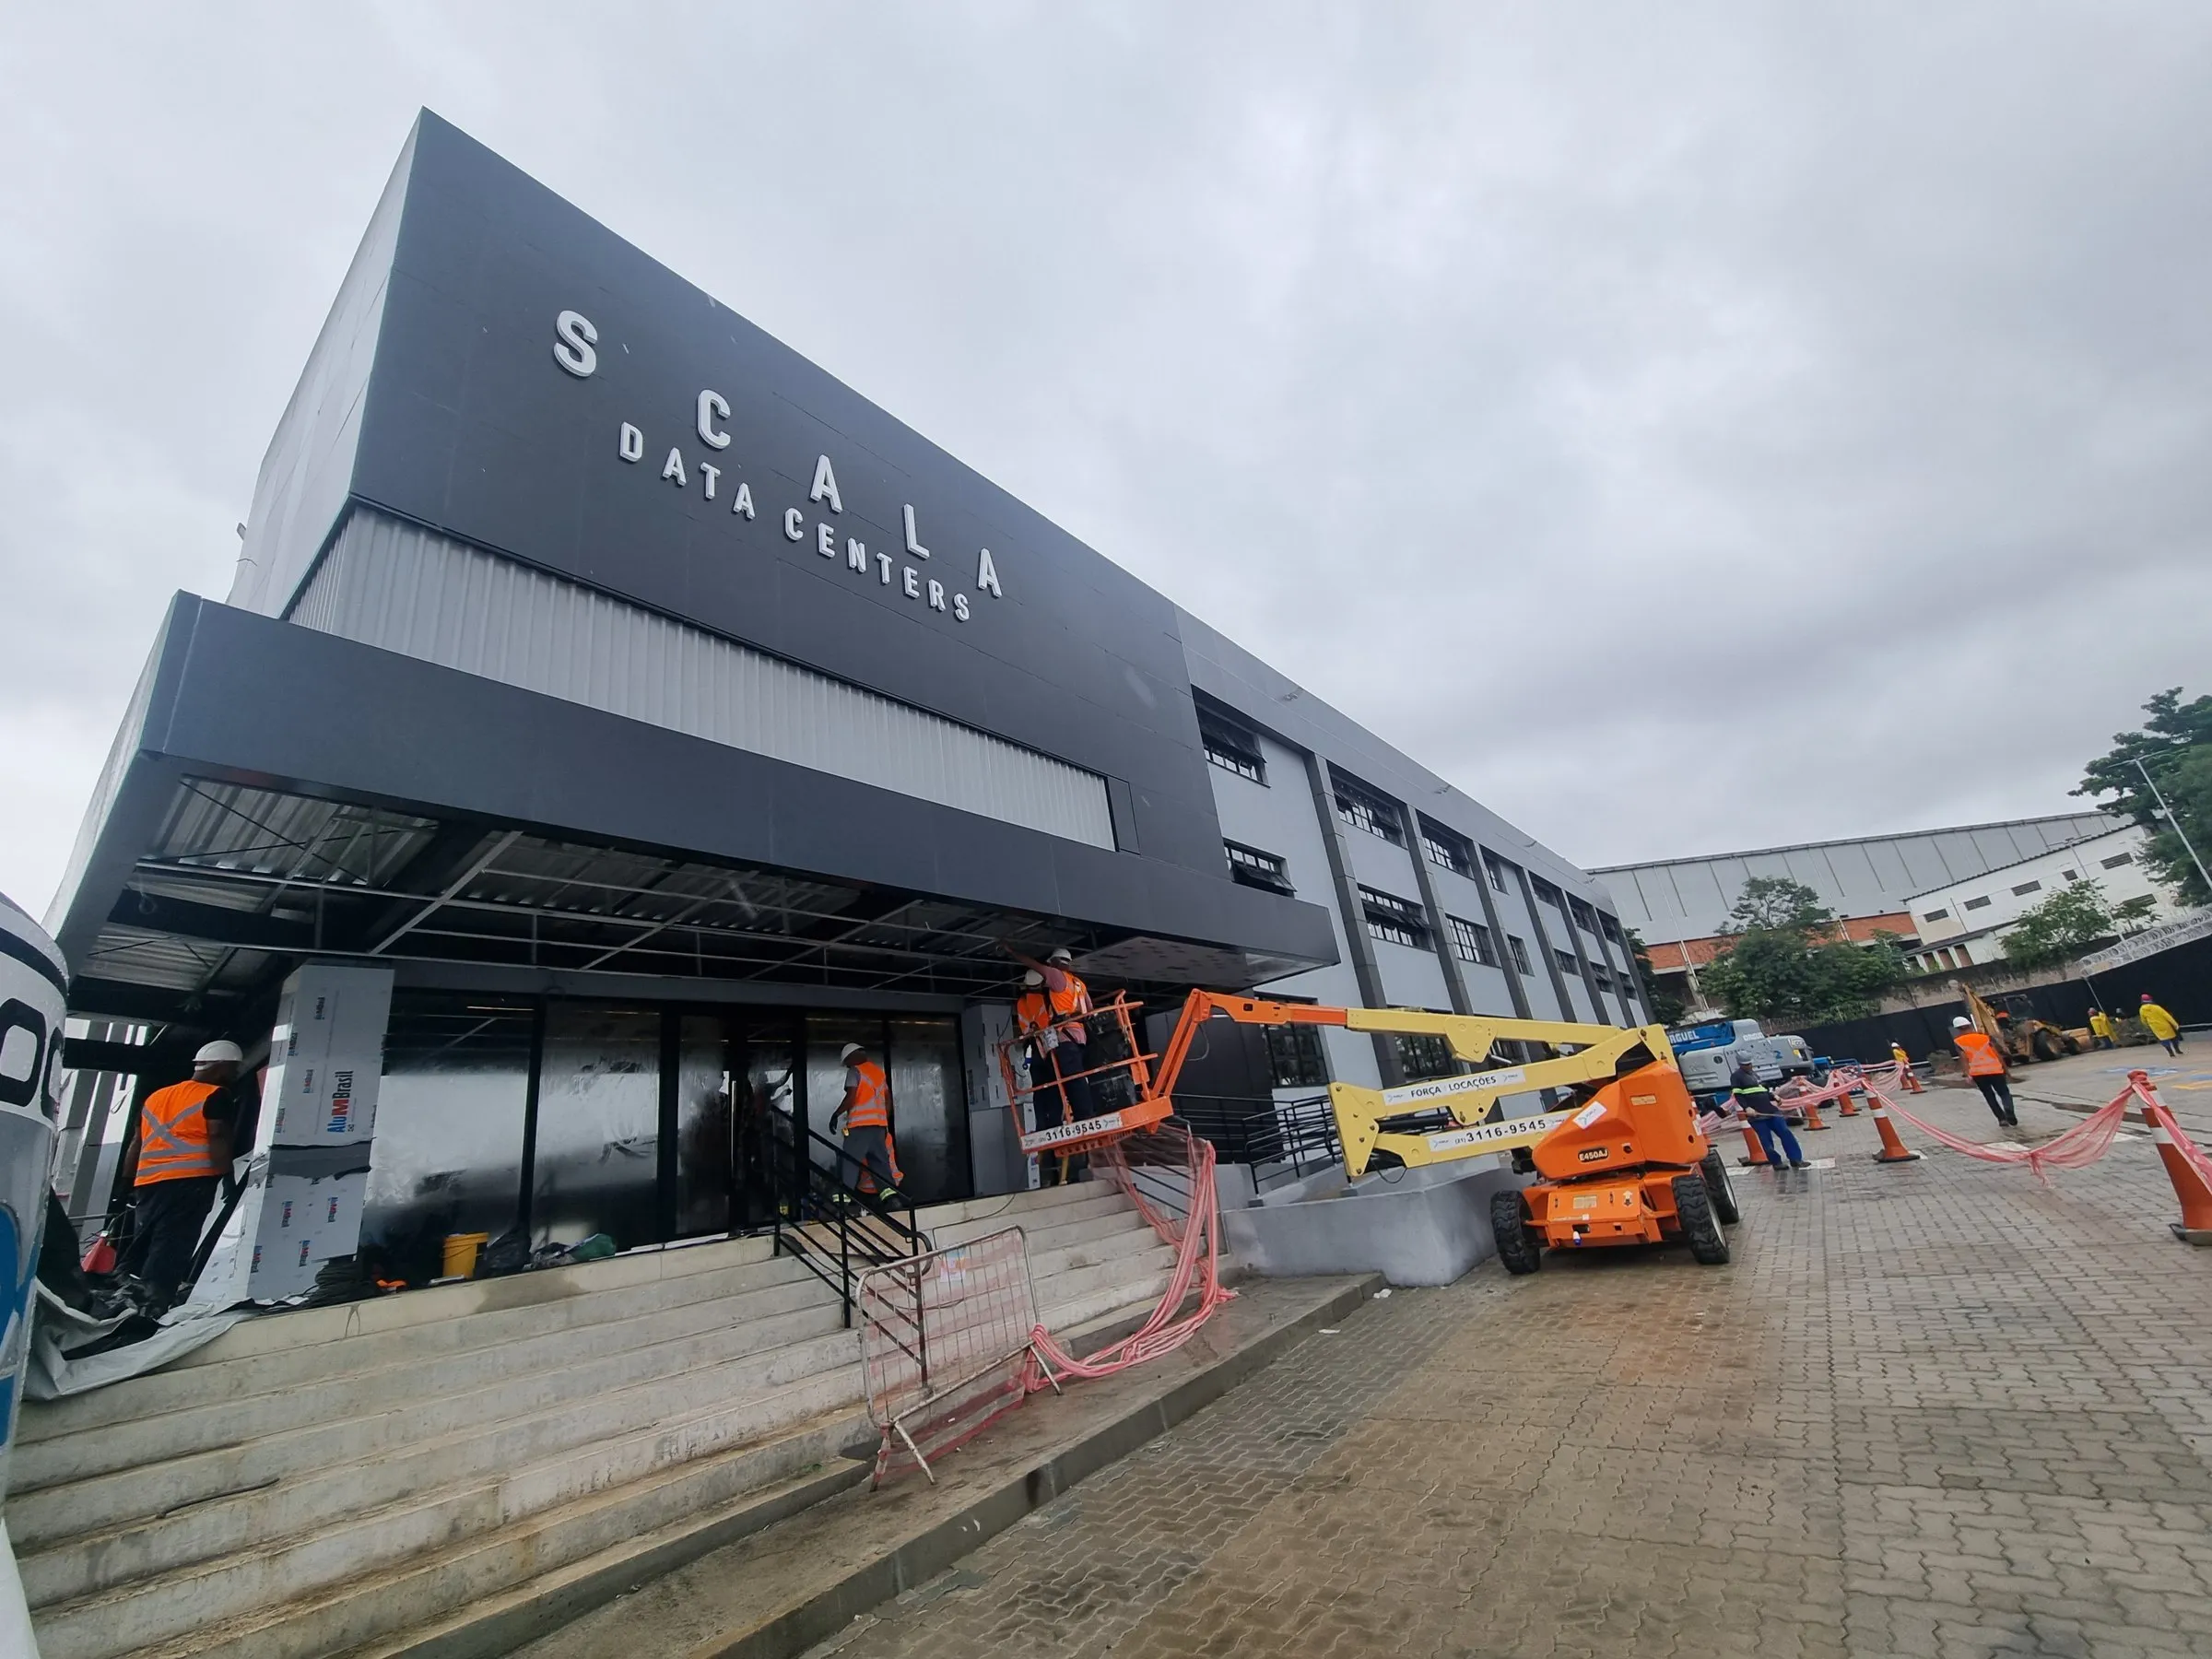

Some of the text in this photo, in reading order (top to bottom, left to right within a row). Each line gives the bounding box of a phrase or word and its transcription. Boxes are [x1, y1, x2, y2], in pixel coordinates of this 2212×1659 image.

[553, 310, 1002, 598] SCALA
[618, 421, 971, 622] DATA CENTERS
[1669, 1030, 1700, 1044] RGUEL
[1410, 1086, 1441, 1099] FORÇA
[1448, 1076, 1497, 1091] LOCAÇÕES
[327, 1070, 354, 1133] AluMBrasil
[1045, 1120, 1102, 1142] 3116-9545
[1466, 1119, 1547, 1143] 3116-9545
[1579, 1149, 1608, 1162] E450AJ
